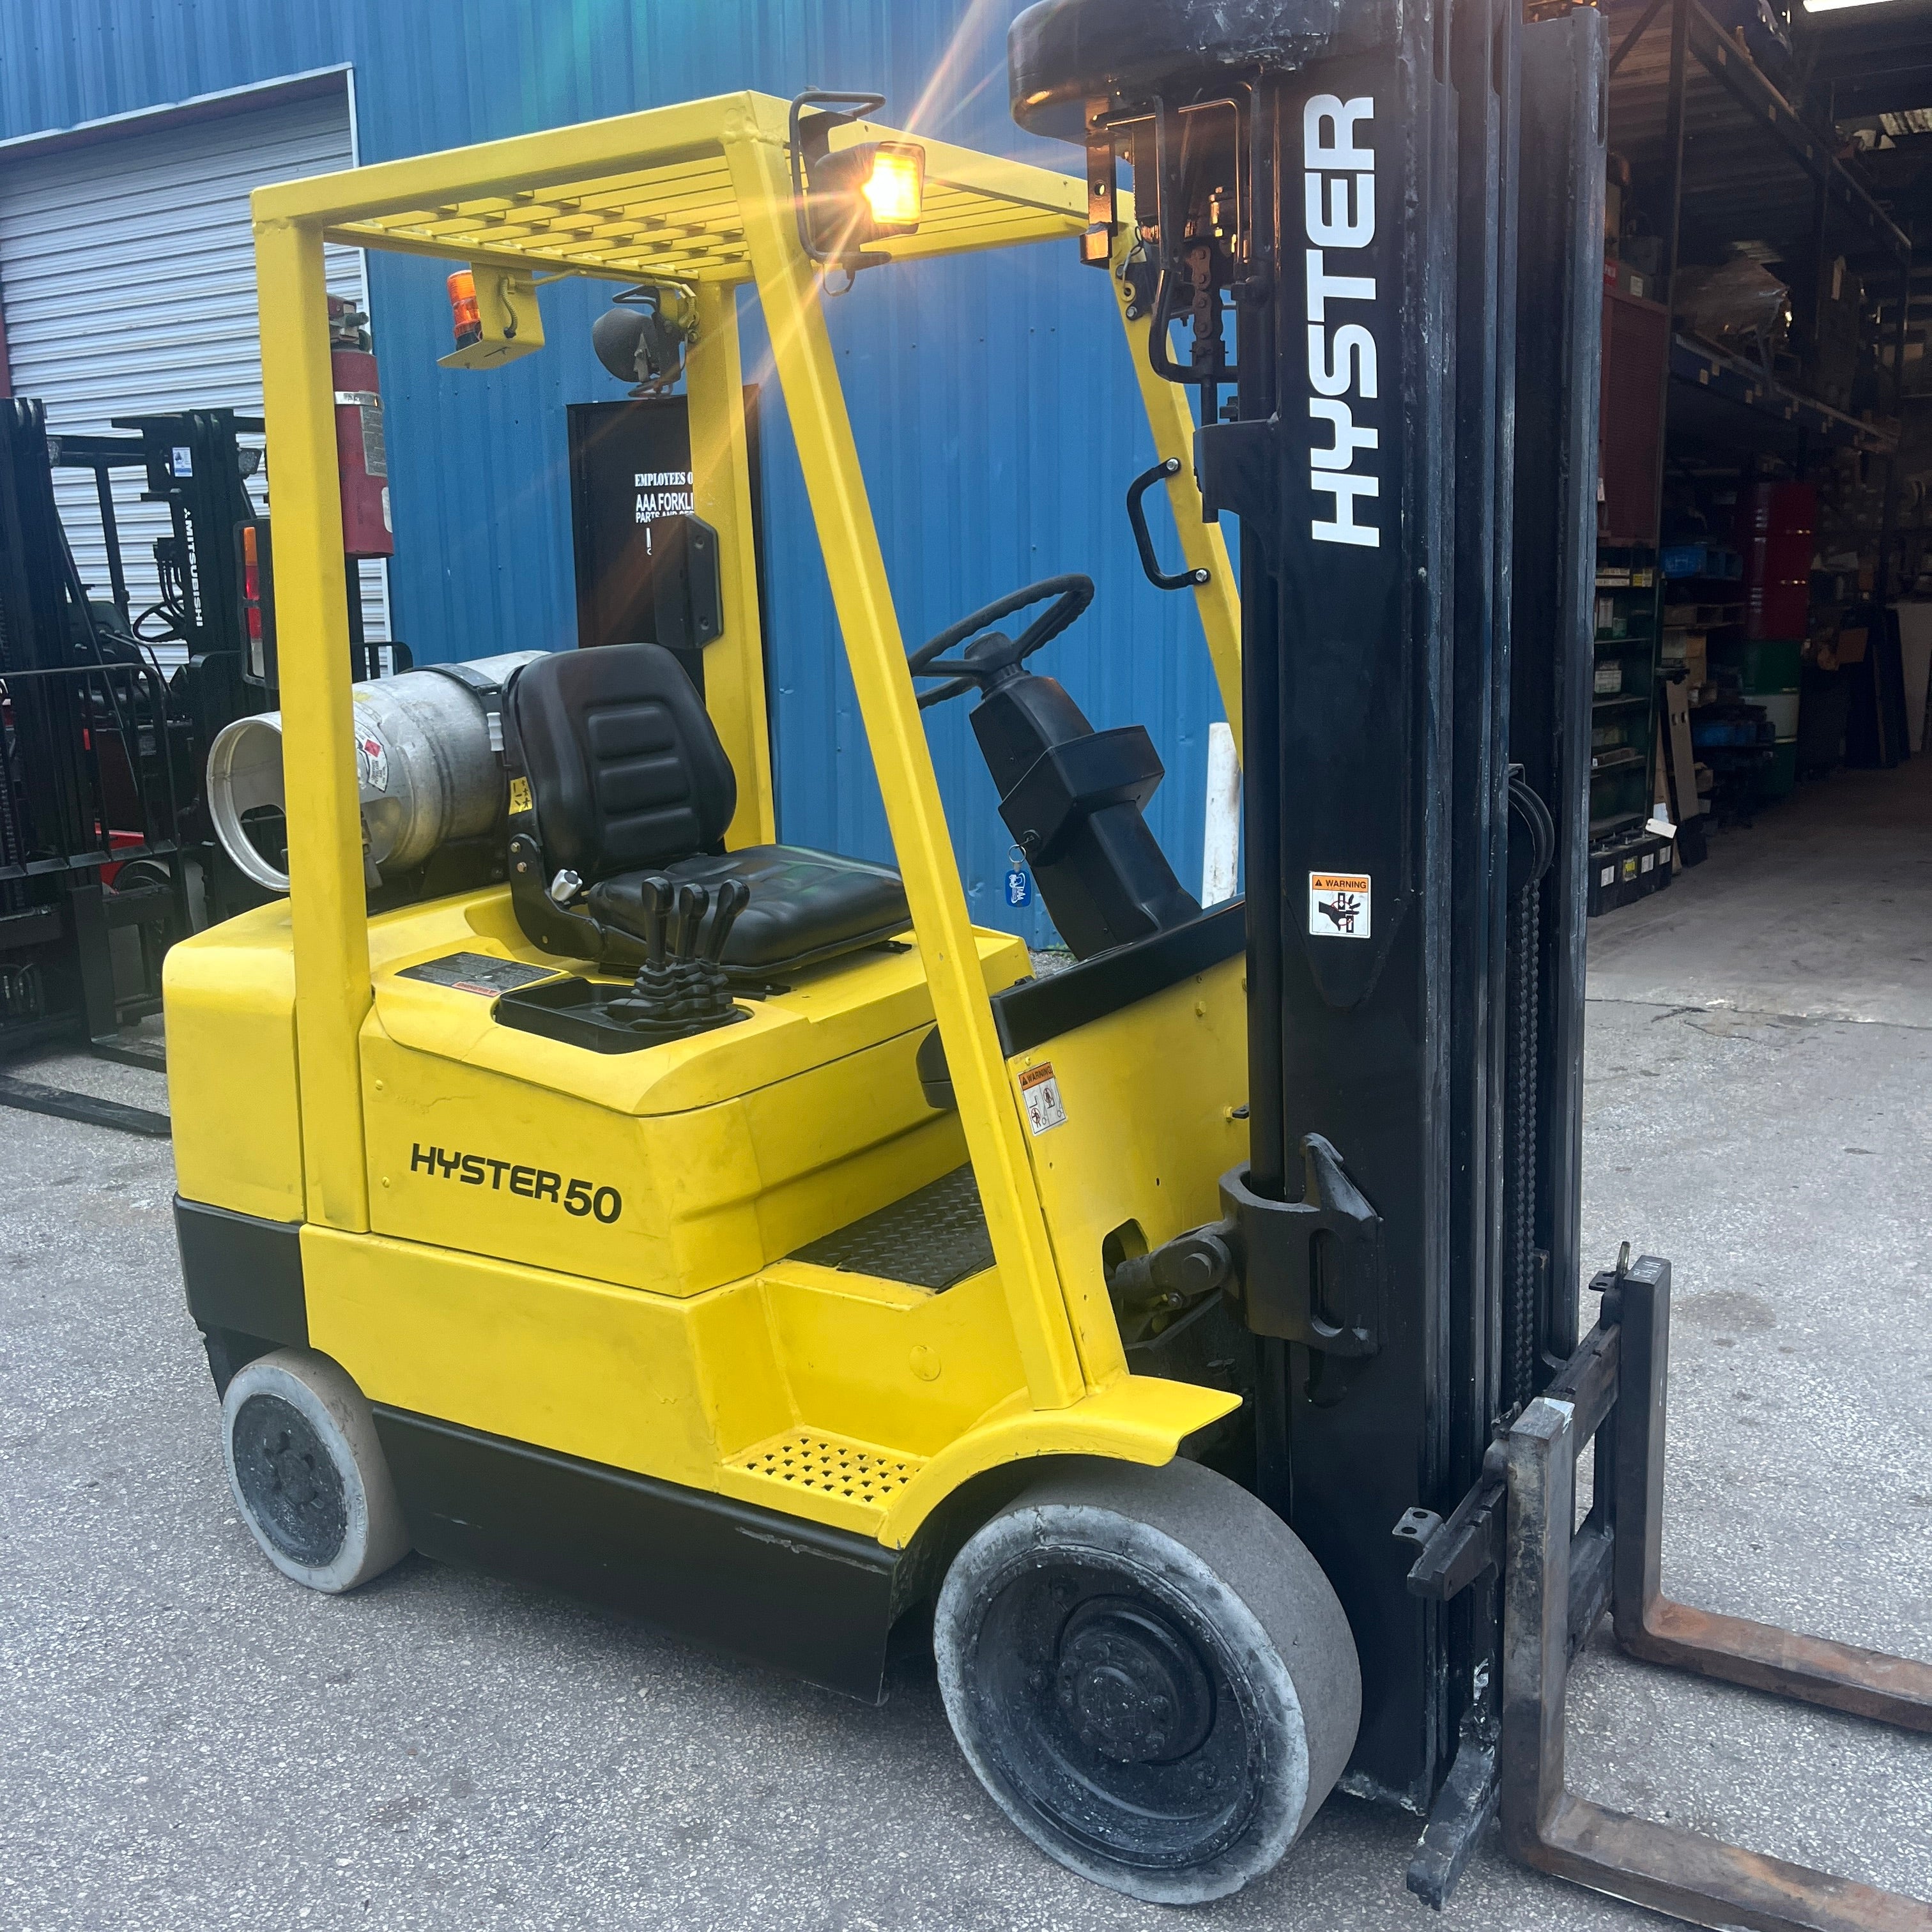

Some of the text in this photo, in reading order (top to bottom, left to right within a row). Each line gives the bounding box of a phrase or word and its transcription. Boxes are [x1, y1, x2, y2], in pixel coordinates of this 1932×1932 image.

[1303, 93, 1380, 548] HYSTER
[634, 471, 693, 486] EMPLOYEES O
[636, 493, 694, 511] AAA FORKLI
[185, 519, 204, 627] MITSUBISHI
[1325, 879, 1367, 889] WARNING
[1027, 1066, 1054, 1083] WARNING
